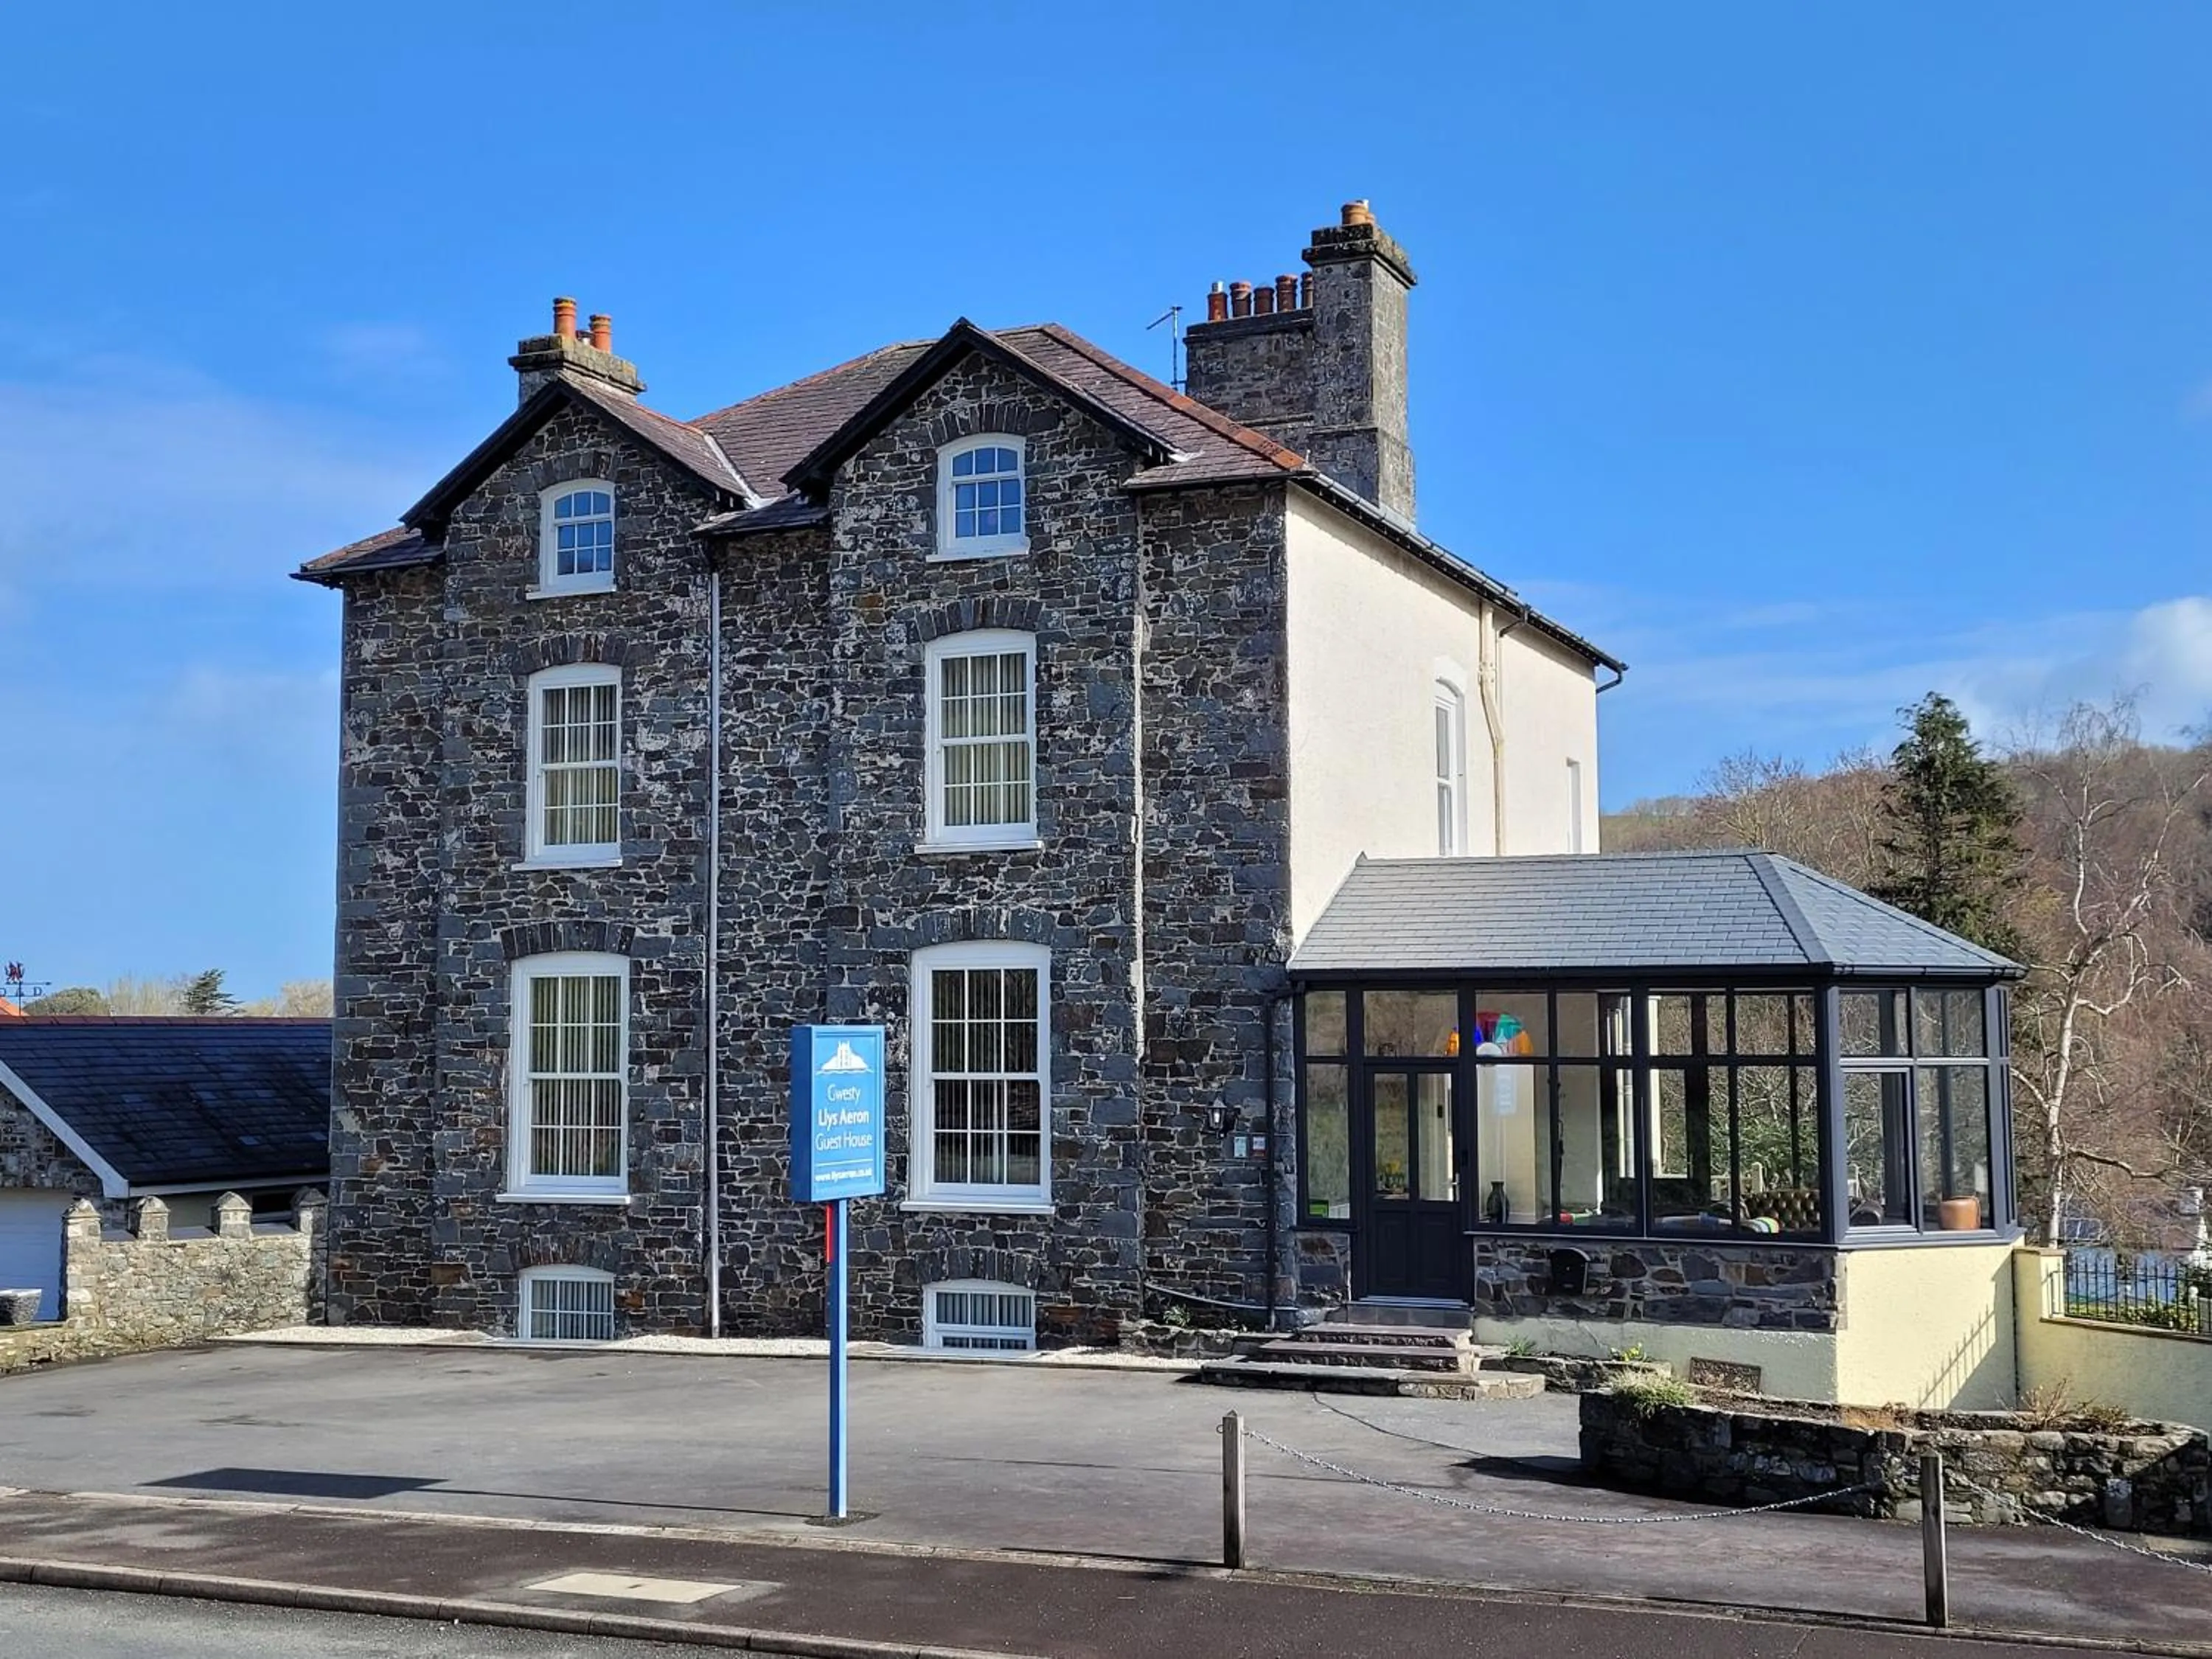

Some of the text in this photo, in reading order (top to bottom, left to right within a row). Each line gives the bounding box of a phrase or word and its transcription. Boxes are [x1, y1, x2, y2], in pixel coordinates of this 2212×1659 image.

[827, 1083, 861, 1105] Gwesty
[818, 1107, 869, 1132] Llys Aeron
[815, 1131, 872, 1151] Guest House
